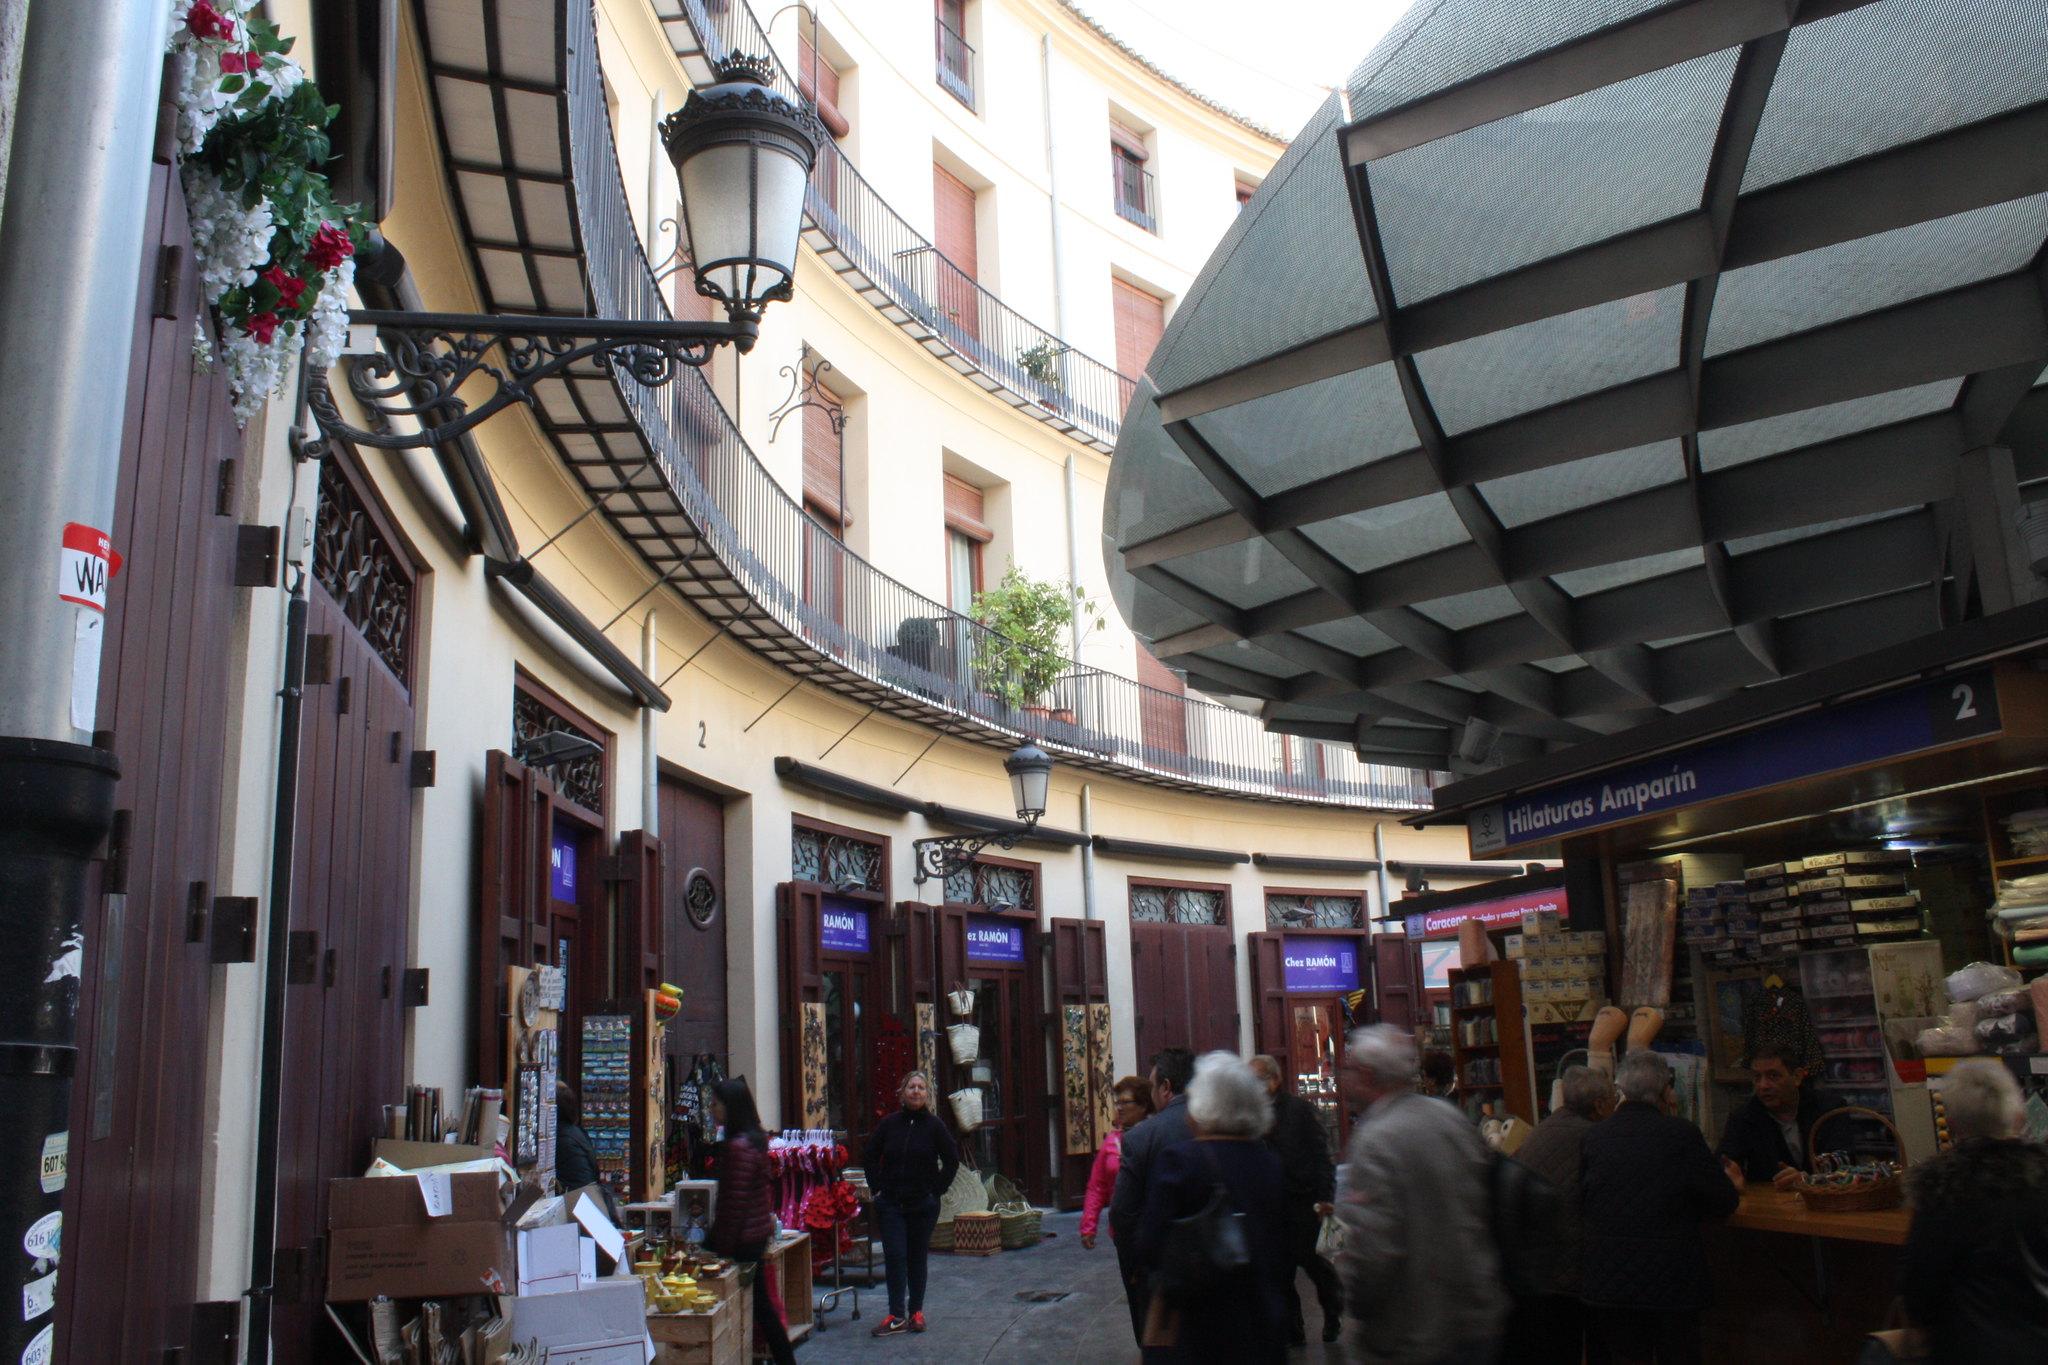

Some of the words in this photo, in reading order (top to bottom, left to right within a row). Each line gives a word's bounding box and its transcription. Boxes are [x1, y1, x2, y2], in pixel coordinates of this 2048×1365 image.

[1952, 684, 1977, 720] 2
[698, 719, 706, 748] 2
[1508, 796, 1594, 834] Hilaturas
[1600, 765, 1697, 812] Amparín
[823, 912, 854, 930] RAMÓN
[978, 928, 1009, 944] RAMÓN
[1285, 957, 1304, 967] Chez
[1305, 954, 1336, 967] RAMÓN
[44, 1155, 59, 1173] 607
[28, 1231, 45, 1248] 616
